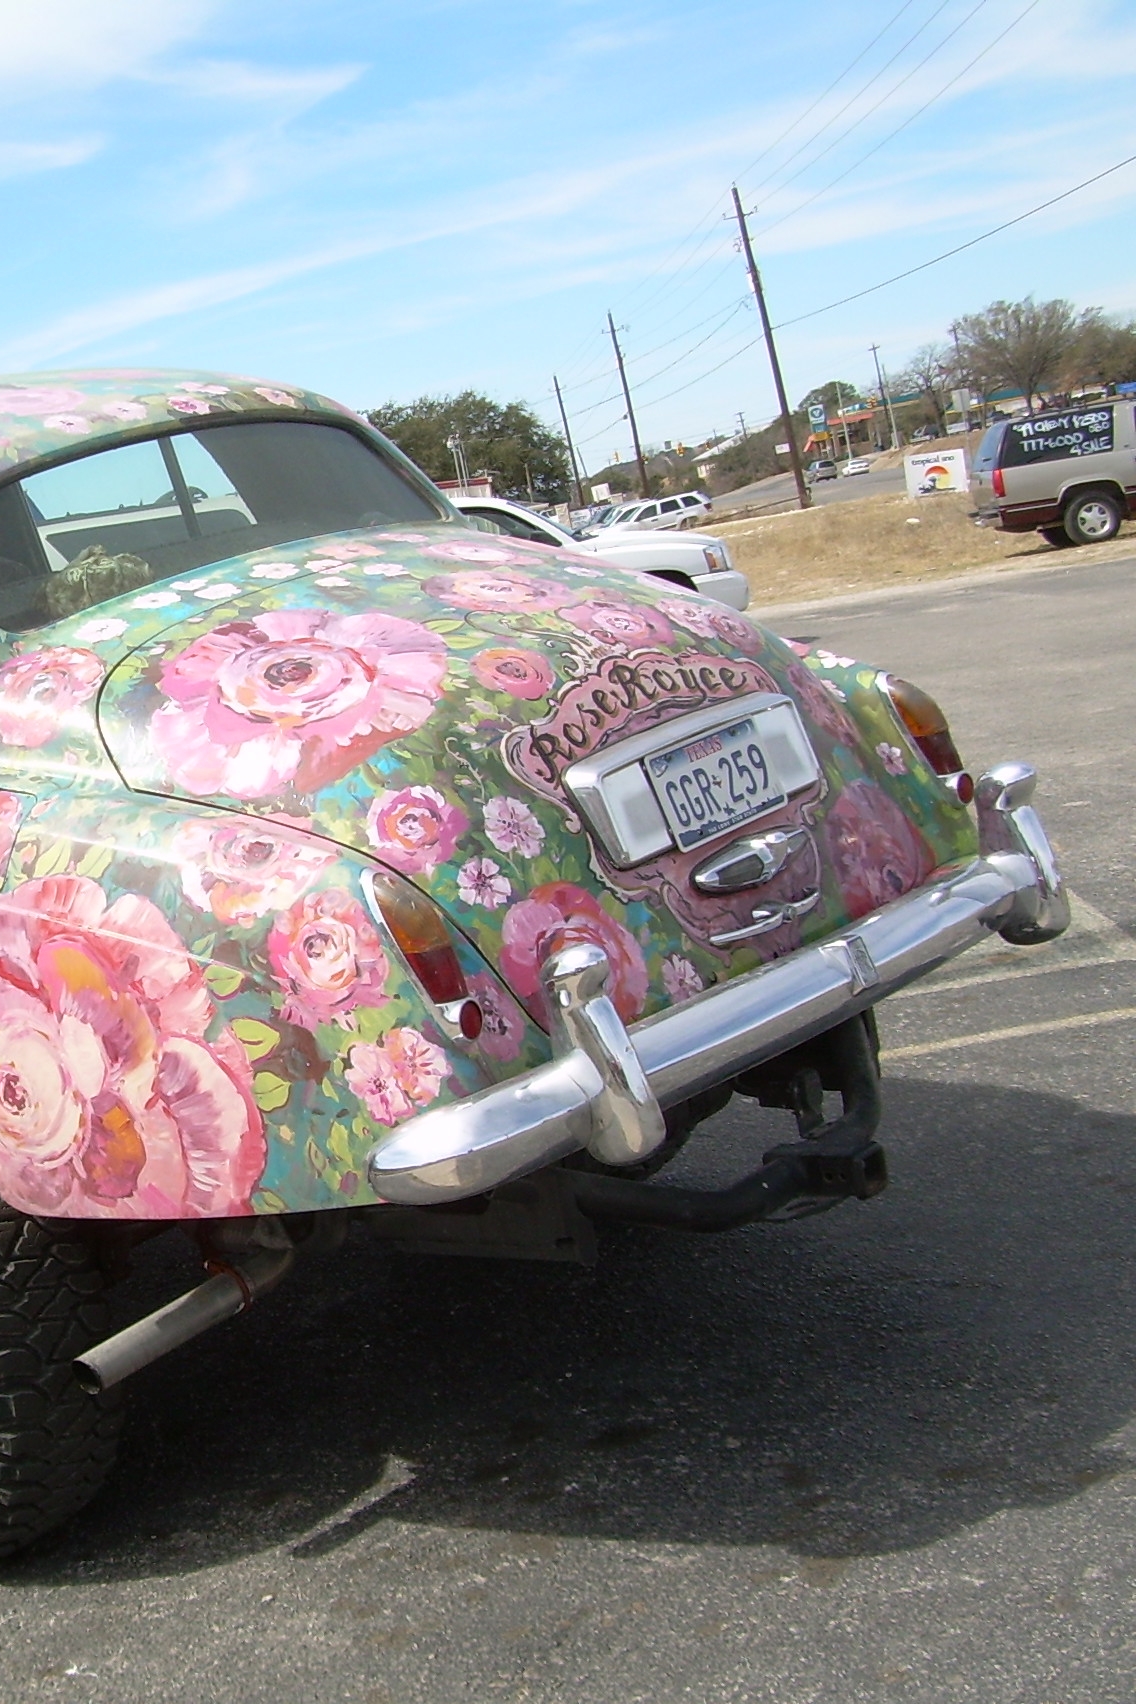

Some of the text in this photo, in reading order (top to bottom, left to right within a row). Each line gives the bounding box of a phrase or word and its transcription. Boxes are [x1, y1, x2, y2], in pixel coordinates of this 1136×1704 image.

[911, 454, 940, 466] tropical
[684, 734, 723, 763] TEXAS
[718, 743, 769, 803] 259
